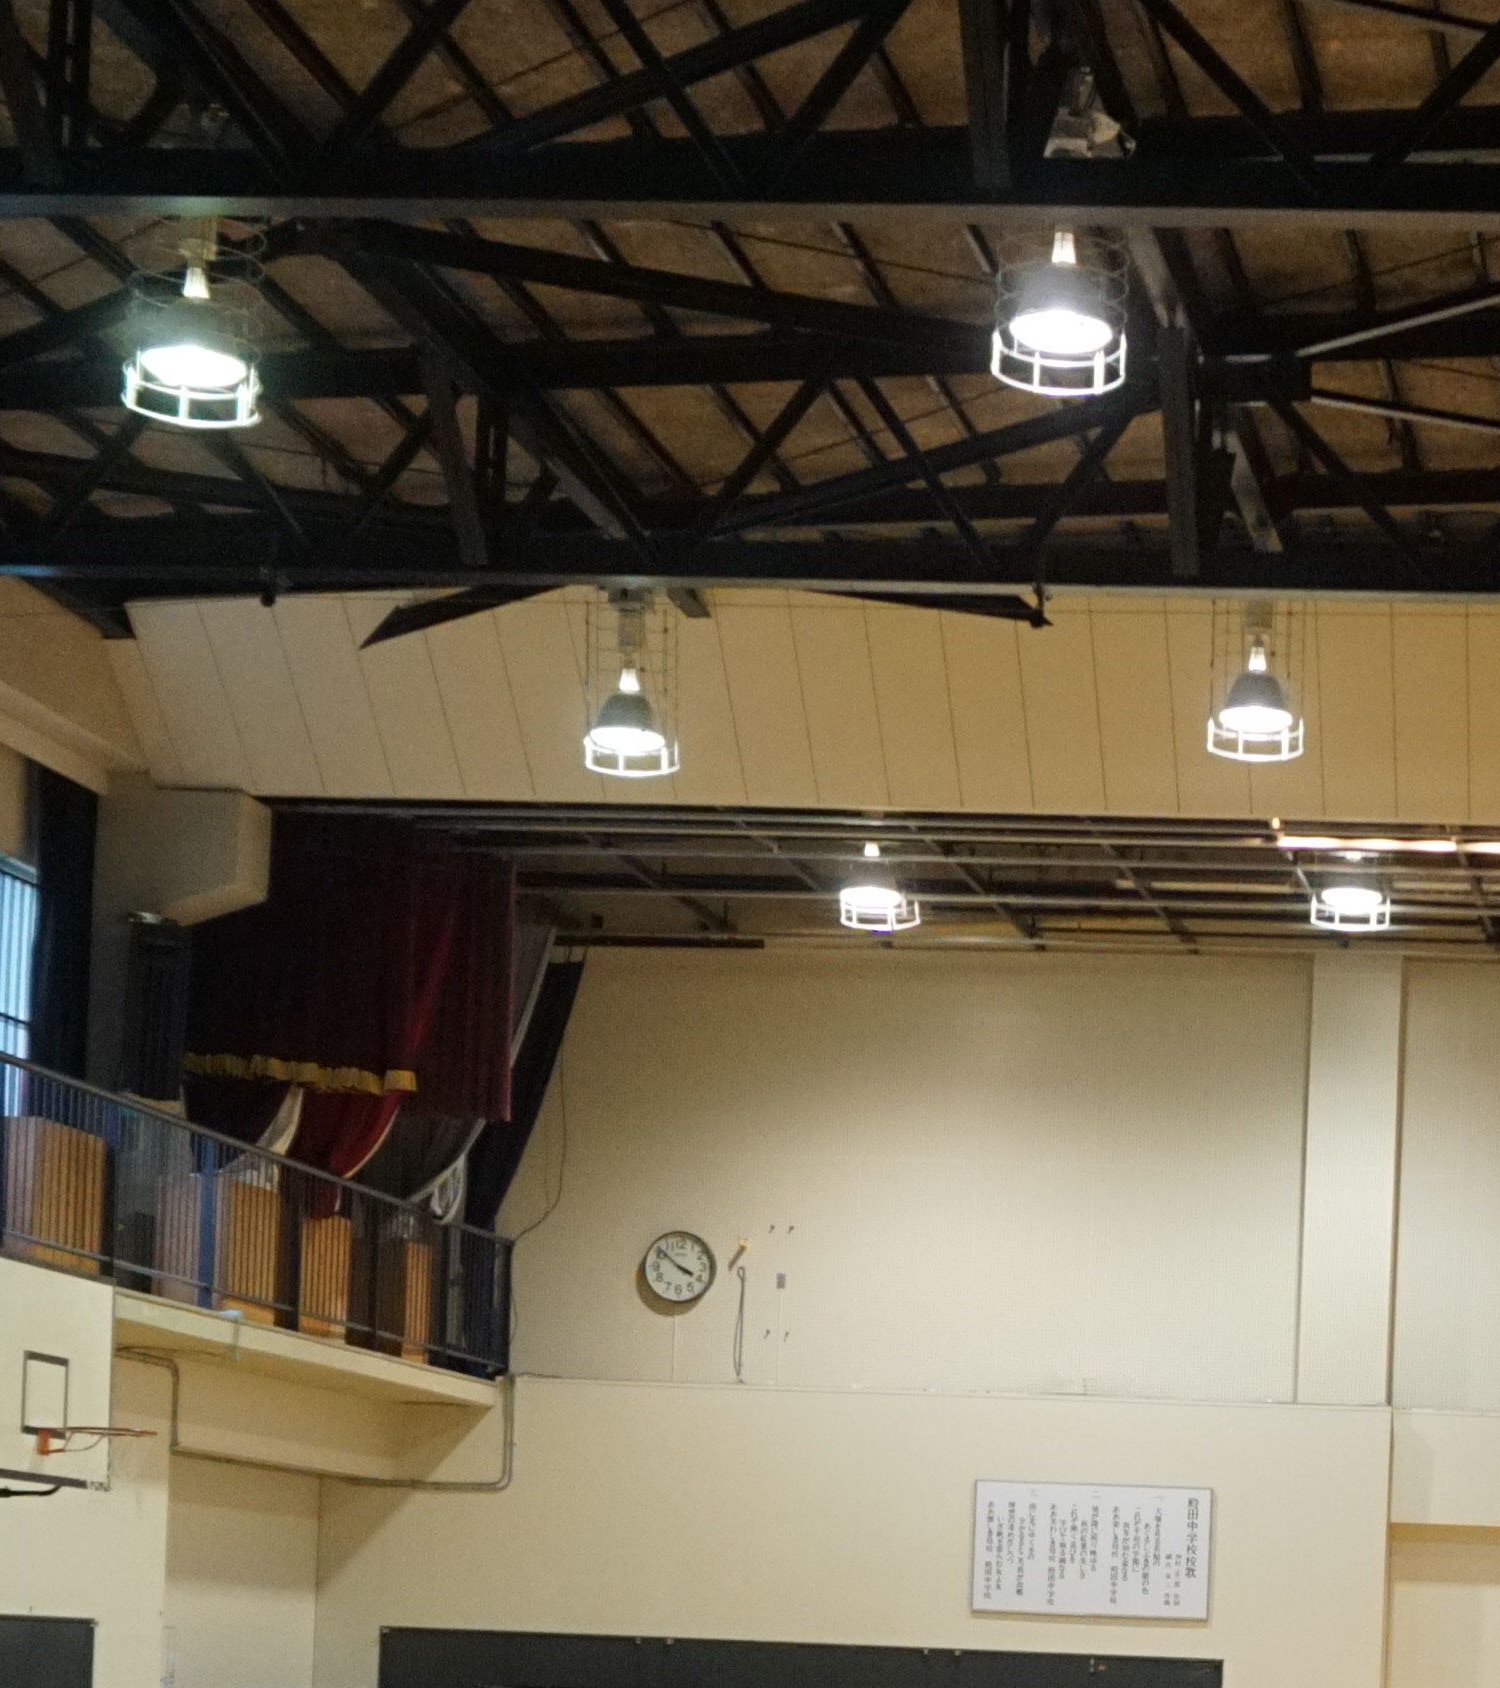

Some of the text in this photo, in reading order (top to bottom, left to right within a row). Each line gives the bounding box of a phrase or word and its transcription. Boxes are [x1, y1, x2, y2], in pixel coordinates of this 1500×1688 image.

[676, 1239, 687, 1250] 12
[653, 1261, 660, 1271] 9
[699, 1262, 706, 1272] 3
[656, 1271, 663, 1282] 8
[675, 1284, 682, 1295] 6
[686, 1281, 694, 1292] 5
